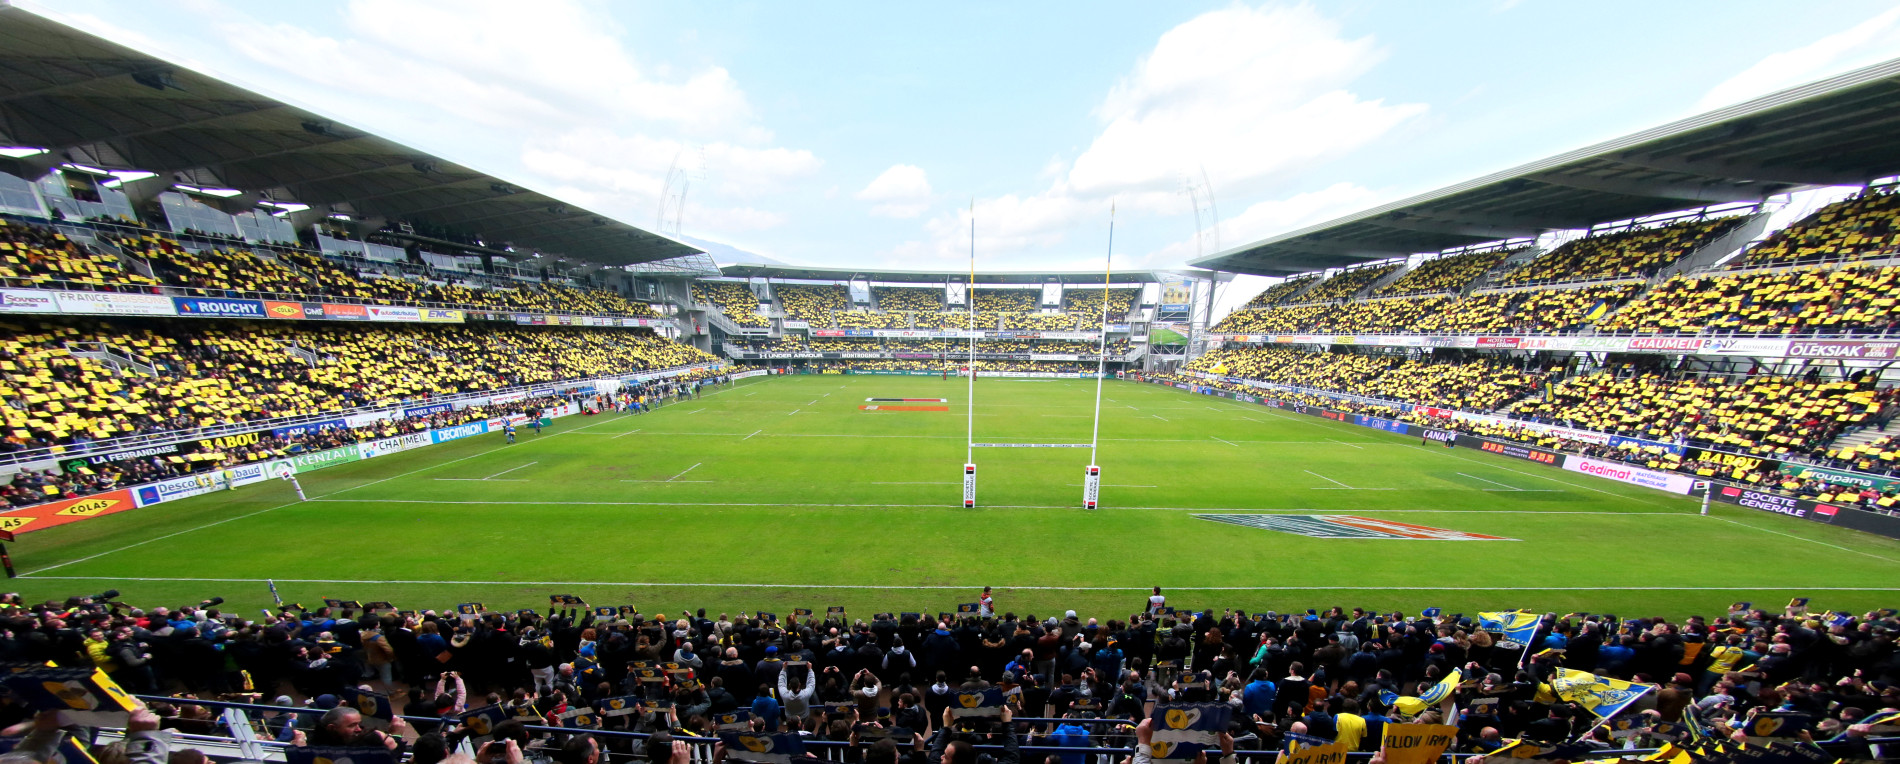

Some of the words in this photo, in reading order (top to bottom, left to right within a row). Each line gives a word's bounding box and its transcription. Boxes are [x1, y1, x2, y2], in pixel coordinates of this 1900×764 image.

[60, 292, 111, 302] FRANCE
[198, 302, 258, 314] ROUCHY
[304, 308, 324, 316] CMF
[1525, 339, 1547, 348] JLM
[1629, 339, 1698, 350] CHAUMEIL
[1789, 345, 1863, 357] OLEKSIAK
[439, 423, 482, 441] DECATHLON
[1577, 433, 1608, 442] omerin
[92, 455, 108, 464] LA
[108, 445, 178, 461] FERRANDAISE
[1579, 462, 1631, 480] Gedimat
[1636, 478, 1668, 488] BRICOLAGE
[1741, 491, 1798, 507] SOCIETE
[70, 500, 108, 514] COLAS
[1739, 498, 1807, 518] GENERALE
